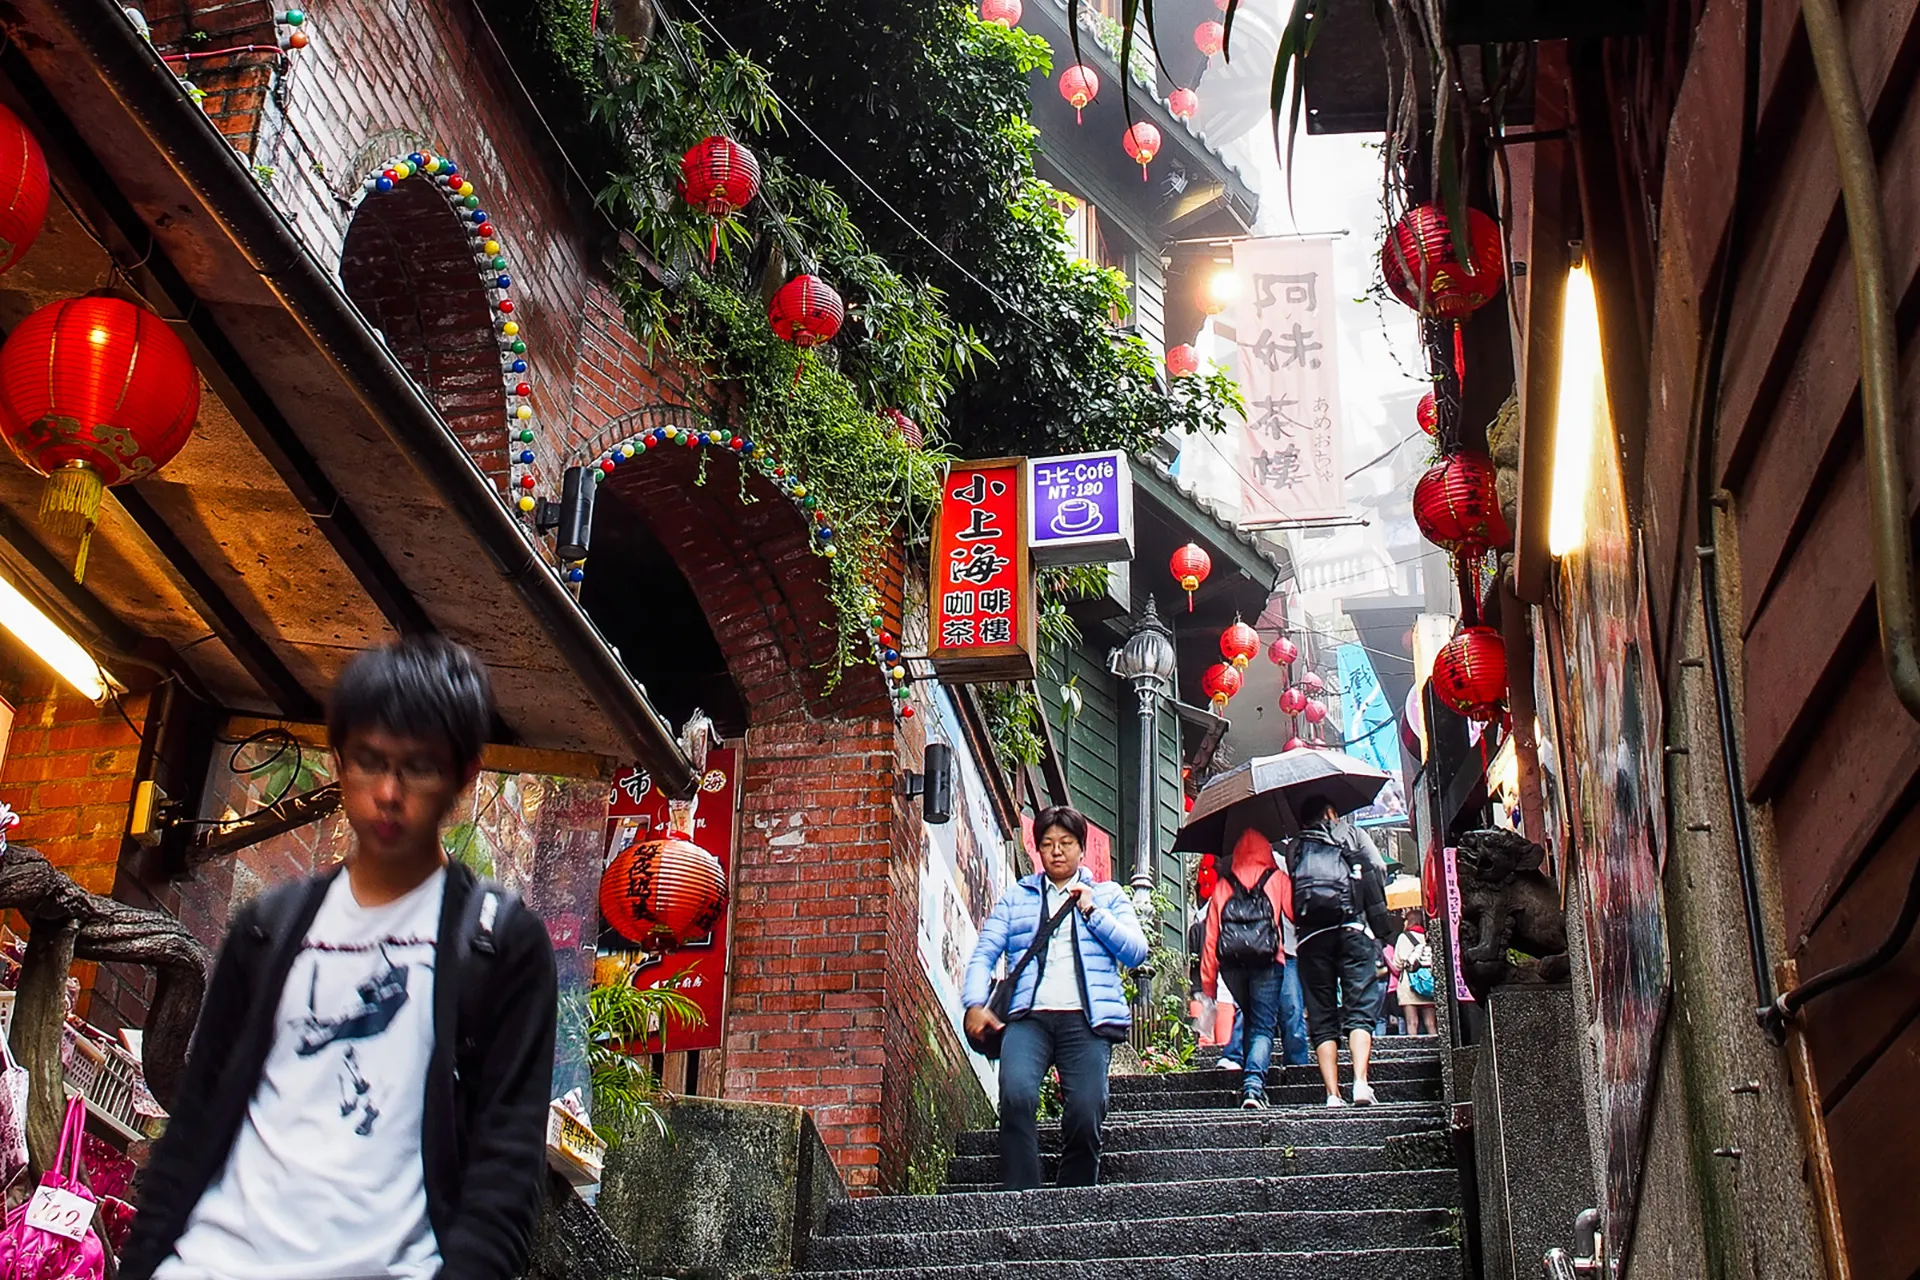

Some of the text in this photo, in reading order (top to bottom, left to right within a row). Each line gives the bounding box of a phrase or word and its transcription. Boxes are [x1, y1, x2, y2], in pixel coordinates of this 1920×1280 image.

[1250, 271, 1322, 489] 阿妹茶樓
[1312, 396, 1333, 482] あめおちゃ
[1048, 481, 1104, 500] NT:120
[950, 474, 1010, 584] 小上海
[944, 589, 1010, 614] 咖啡
[943, 618, 1010, 646] 茶樓
